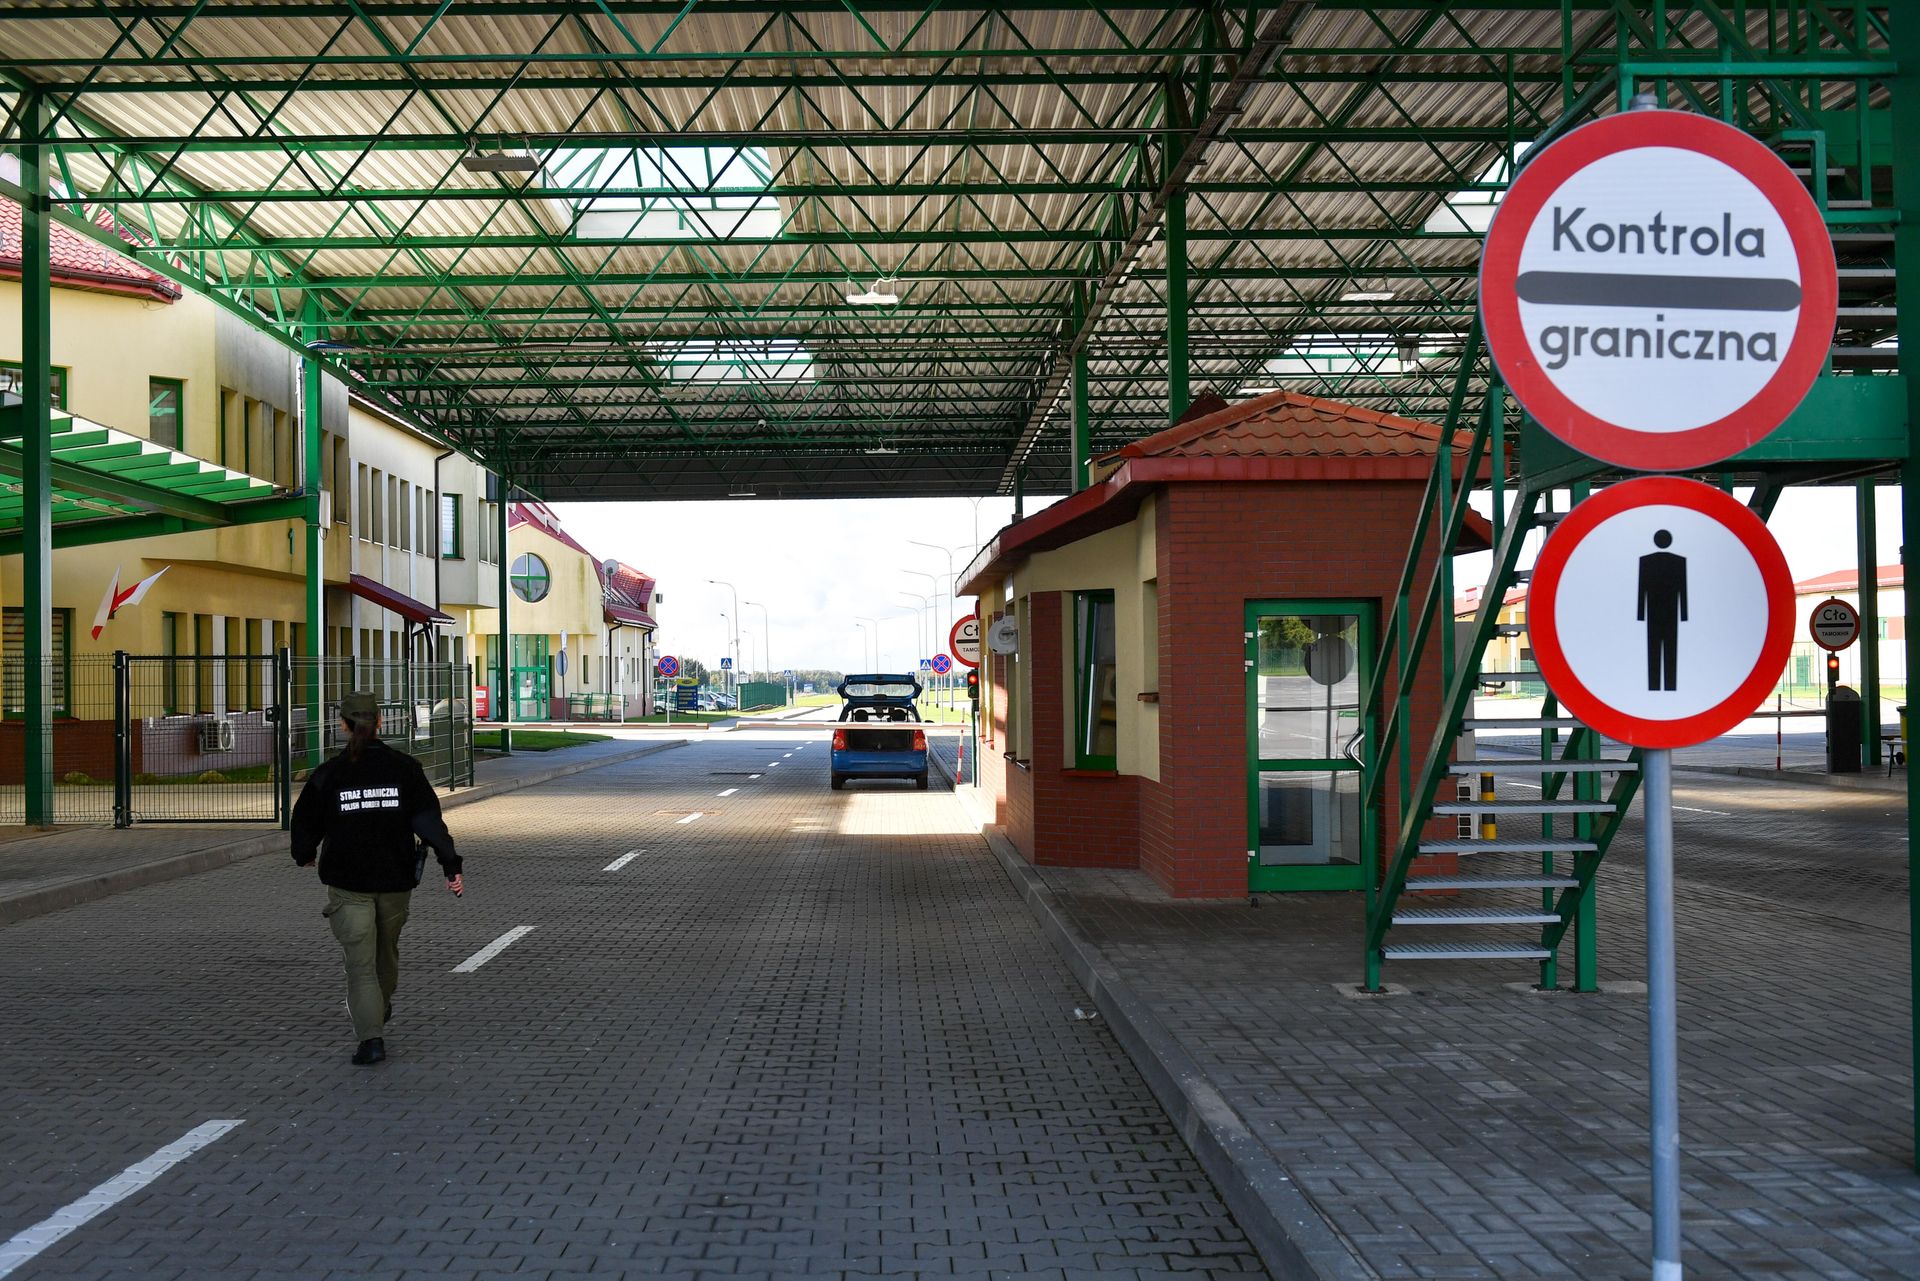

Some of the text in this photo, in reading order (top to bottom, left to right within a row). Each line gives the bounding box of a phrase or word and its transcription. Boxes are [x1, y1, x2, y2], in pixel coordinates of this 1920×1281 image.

[1553, 206, 1765, 258] Kontrola
[1540, 314, 1778, 370] graniczna
[1823, 610, 1847, 620] Cło
[964, 625, 979, 636] Cł
[363, 788, 399, 798] GRANICZNA
[341, 802, 360, 811] POLISH
